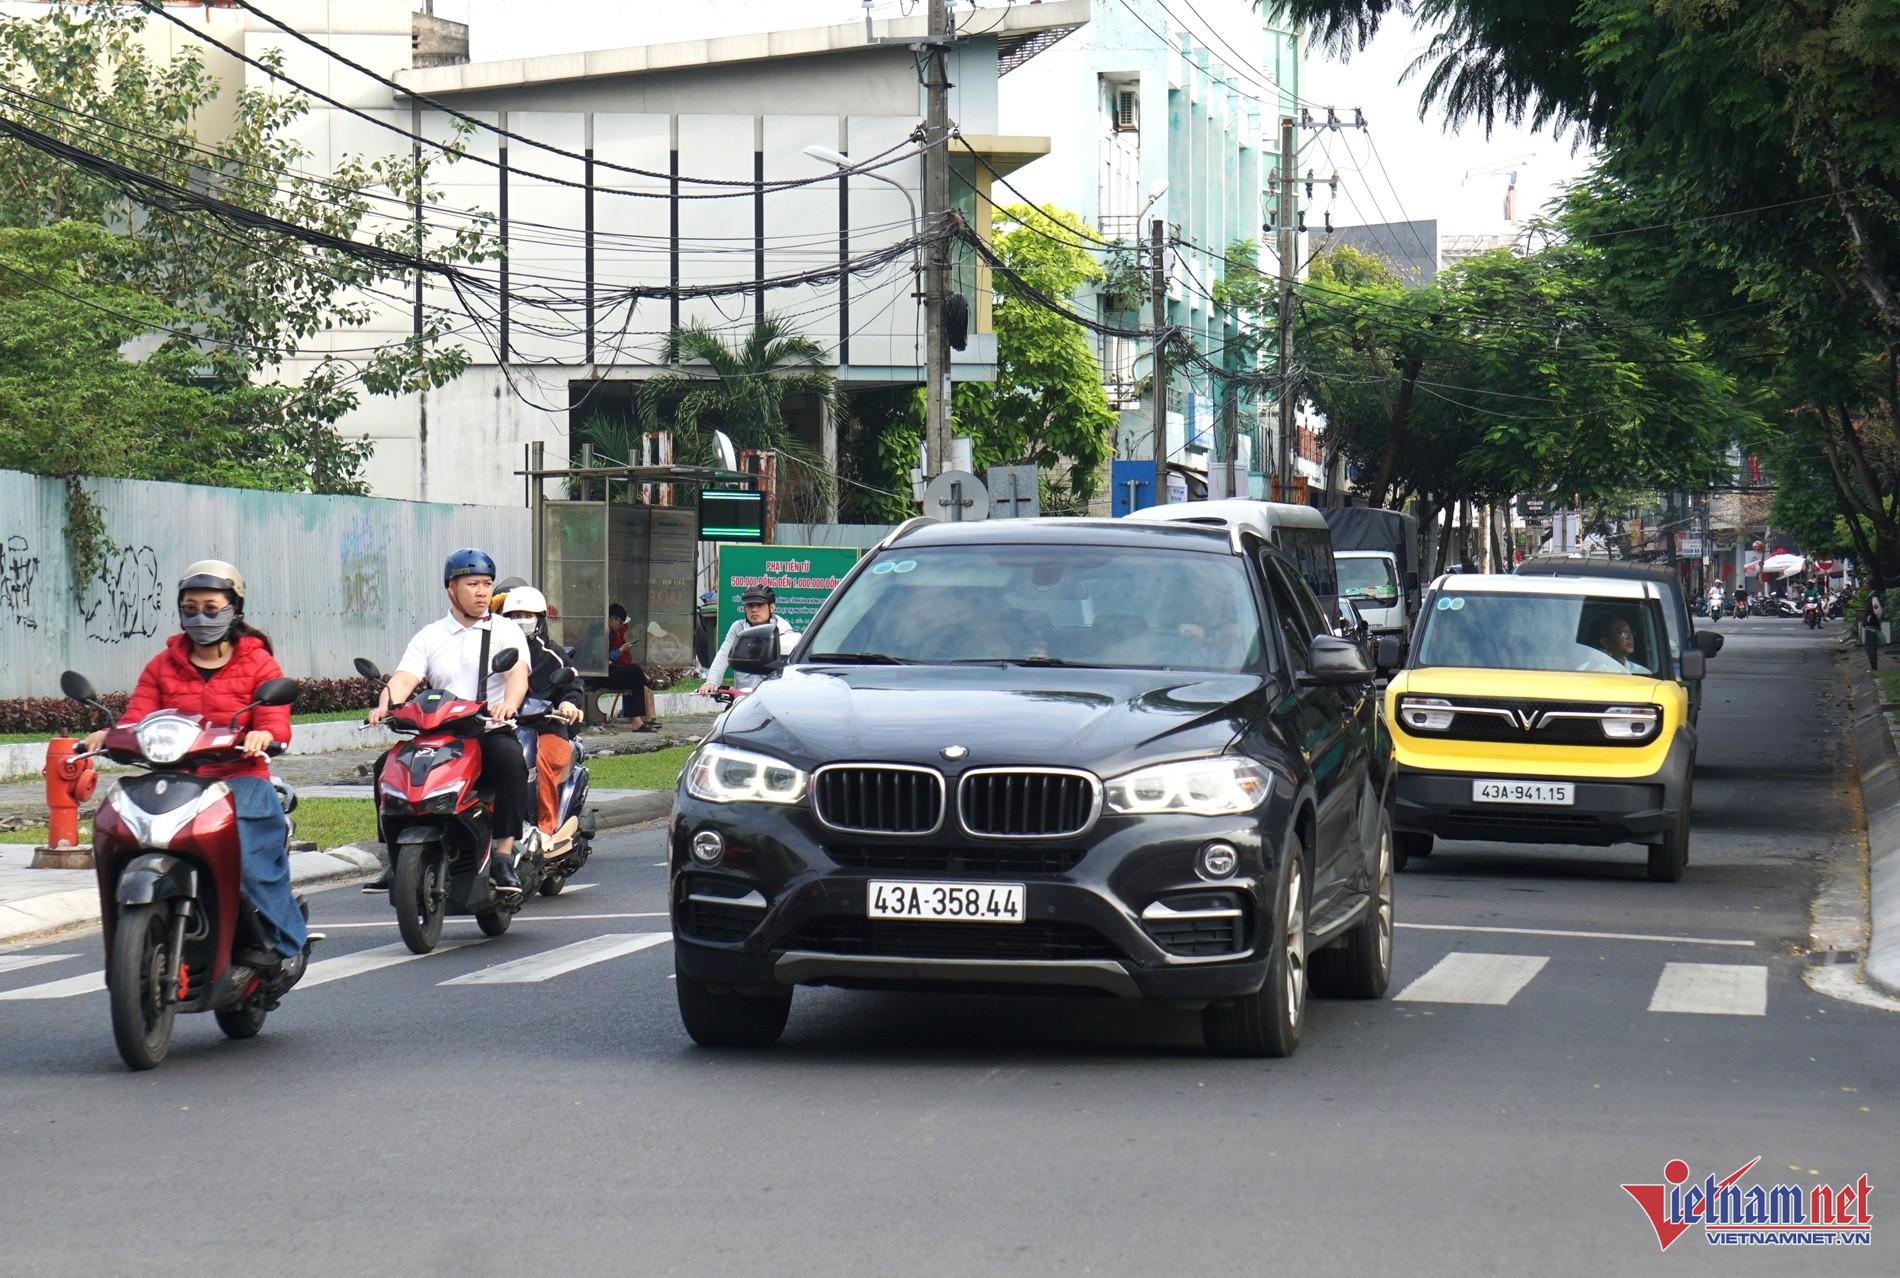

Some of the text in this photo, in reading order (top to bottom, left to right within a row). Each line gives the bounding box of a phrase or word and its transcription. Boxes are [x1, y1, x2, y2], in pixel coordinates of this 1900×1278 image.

[766, 561, 783, 574] PHẠT
[731, 576, 757, 587] 500.000
[792, 577, 824, 588] 1.000.000
[825, 575, 842, 589] ĐỒN
[1481, 785, 1566, 801] 43A-941.15
[874, 886, 1018, 917] 43A-358.44
